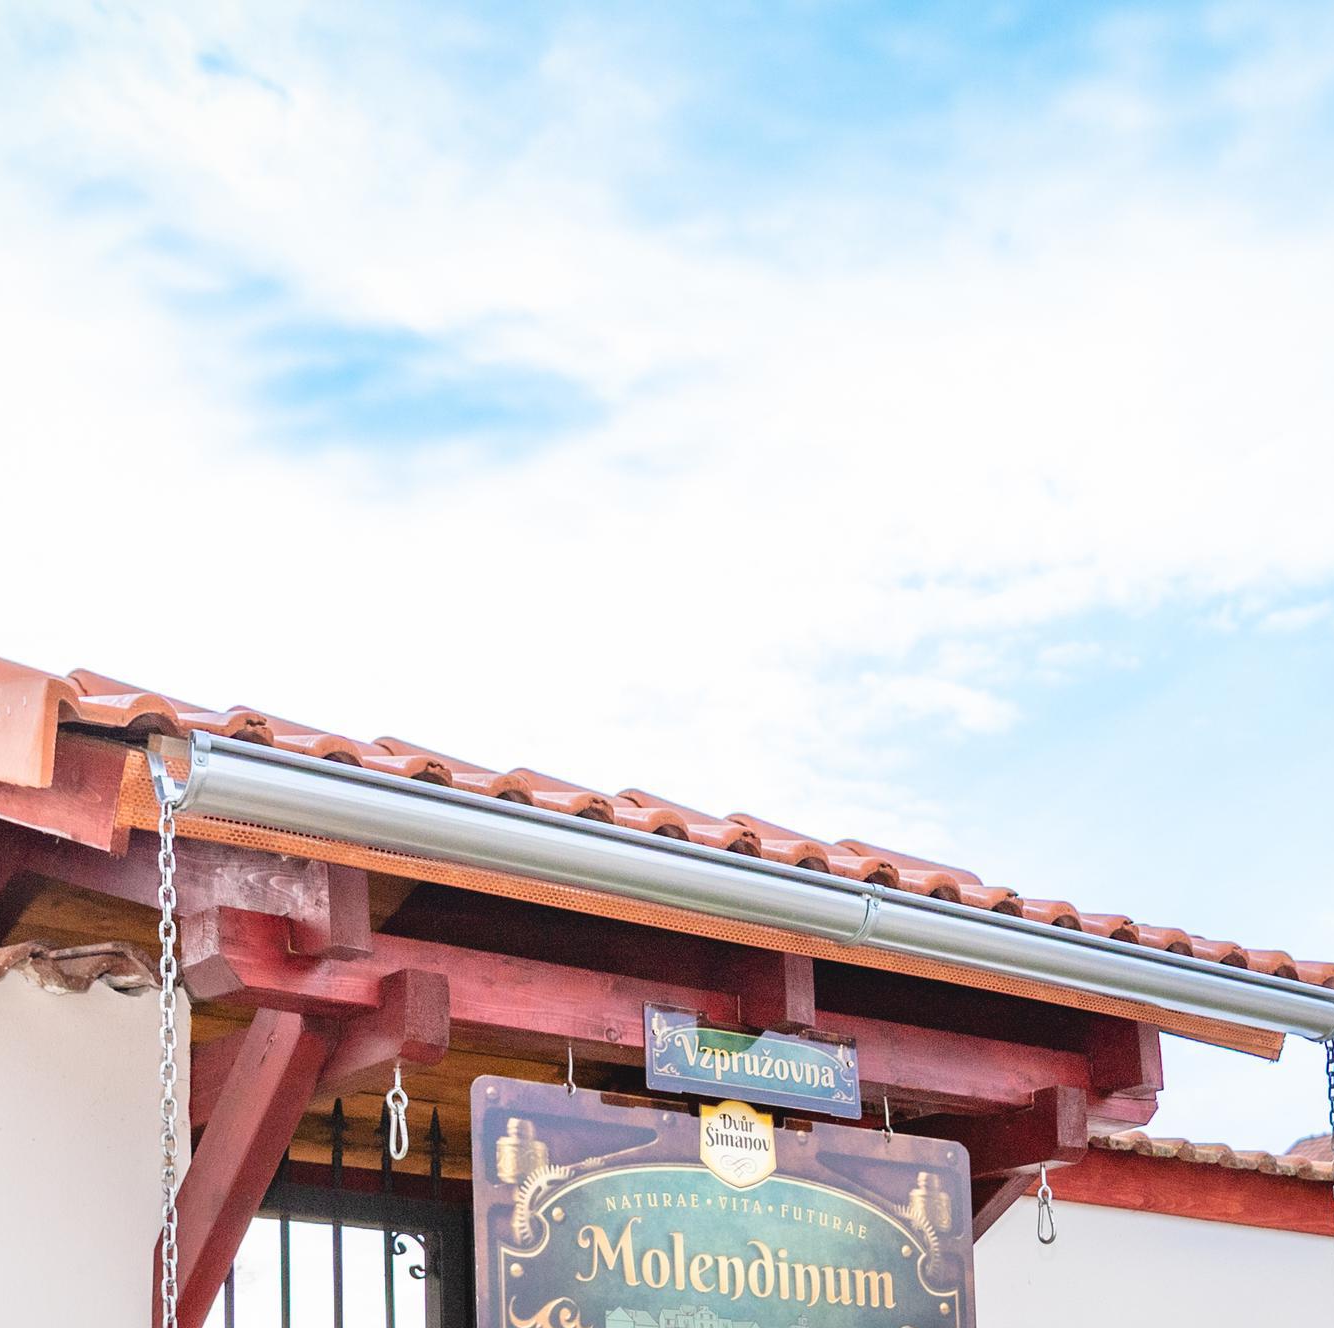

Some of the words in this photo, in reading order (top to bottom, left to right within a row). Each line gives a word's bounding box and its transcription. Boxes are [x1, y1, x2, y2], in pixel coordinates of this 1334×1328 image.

[674, 1033, 836, 1089] Vzpružovna
[705, 1121, 771, 1154] Šimanov
[719, 1112, 755, 1133] Dvůr
[605, 1191, 700, 1212] NATURAE
[719, 1195, 763, 1213] VITA
[781, 1204, 868, 1240] FUTURAE
[575, 1216, 897, 1309] Molendinum
